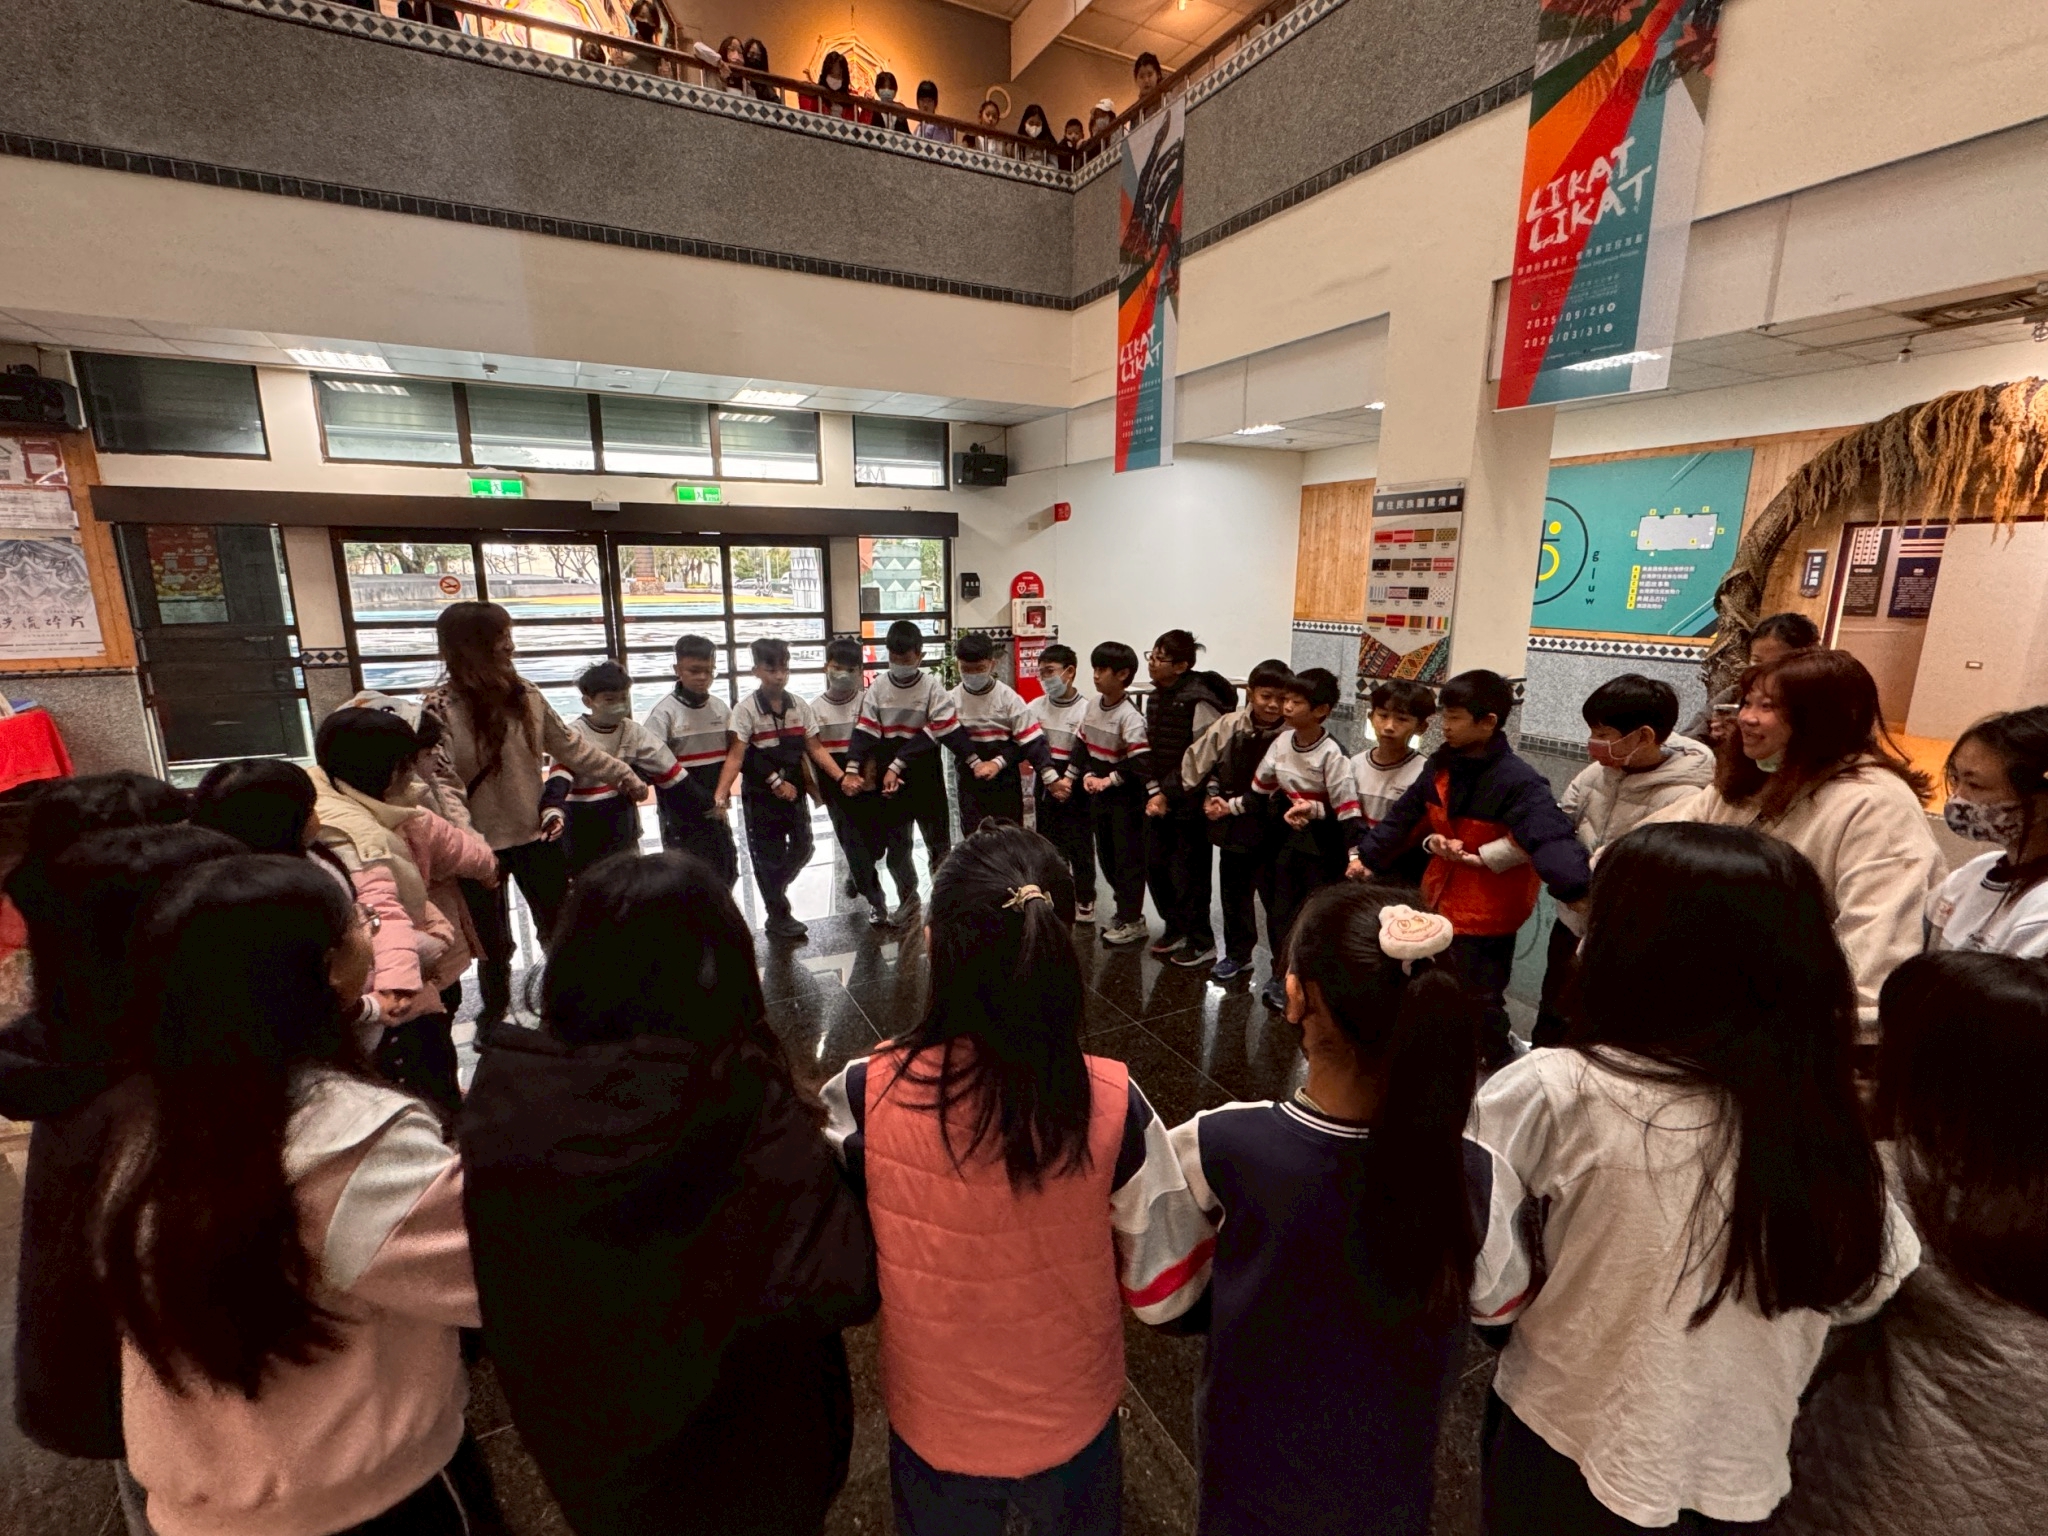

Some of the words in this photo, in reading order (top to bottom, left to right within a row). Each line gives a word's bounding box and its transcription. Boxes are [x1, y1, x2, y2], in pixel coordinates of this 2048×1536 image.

[1526, 136, 1636, 223] LIKAT
[1528, 164, 1653, 253] LIKAT
[1524, 325, 1601, 348] 2026/03/31
[1526, 304, 1604, 330] 2025/09/26
[1120, 323, 1156, 365] LIKAT
[1121, 341, 1162, 383] LIKAT
